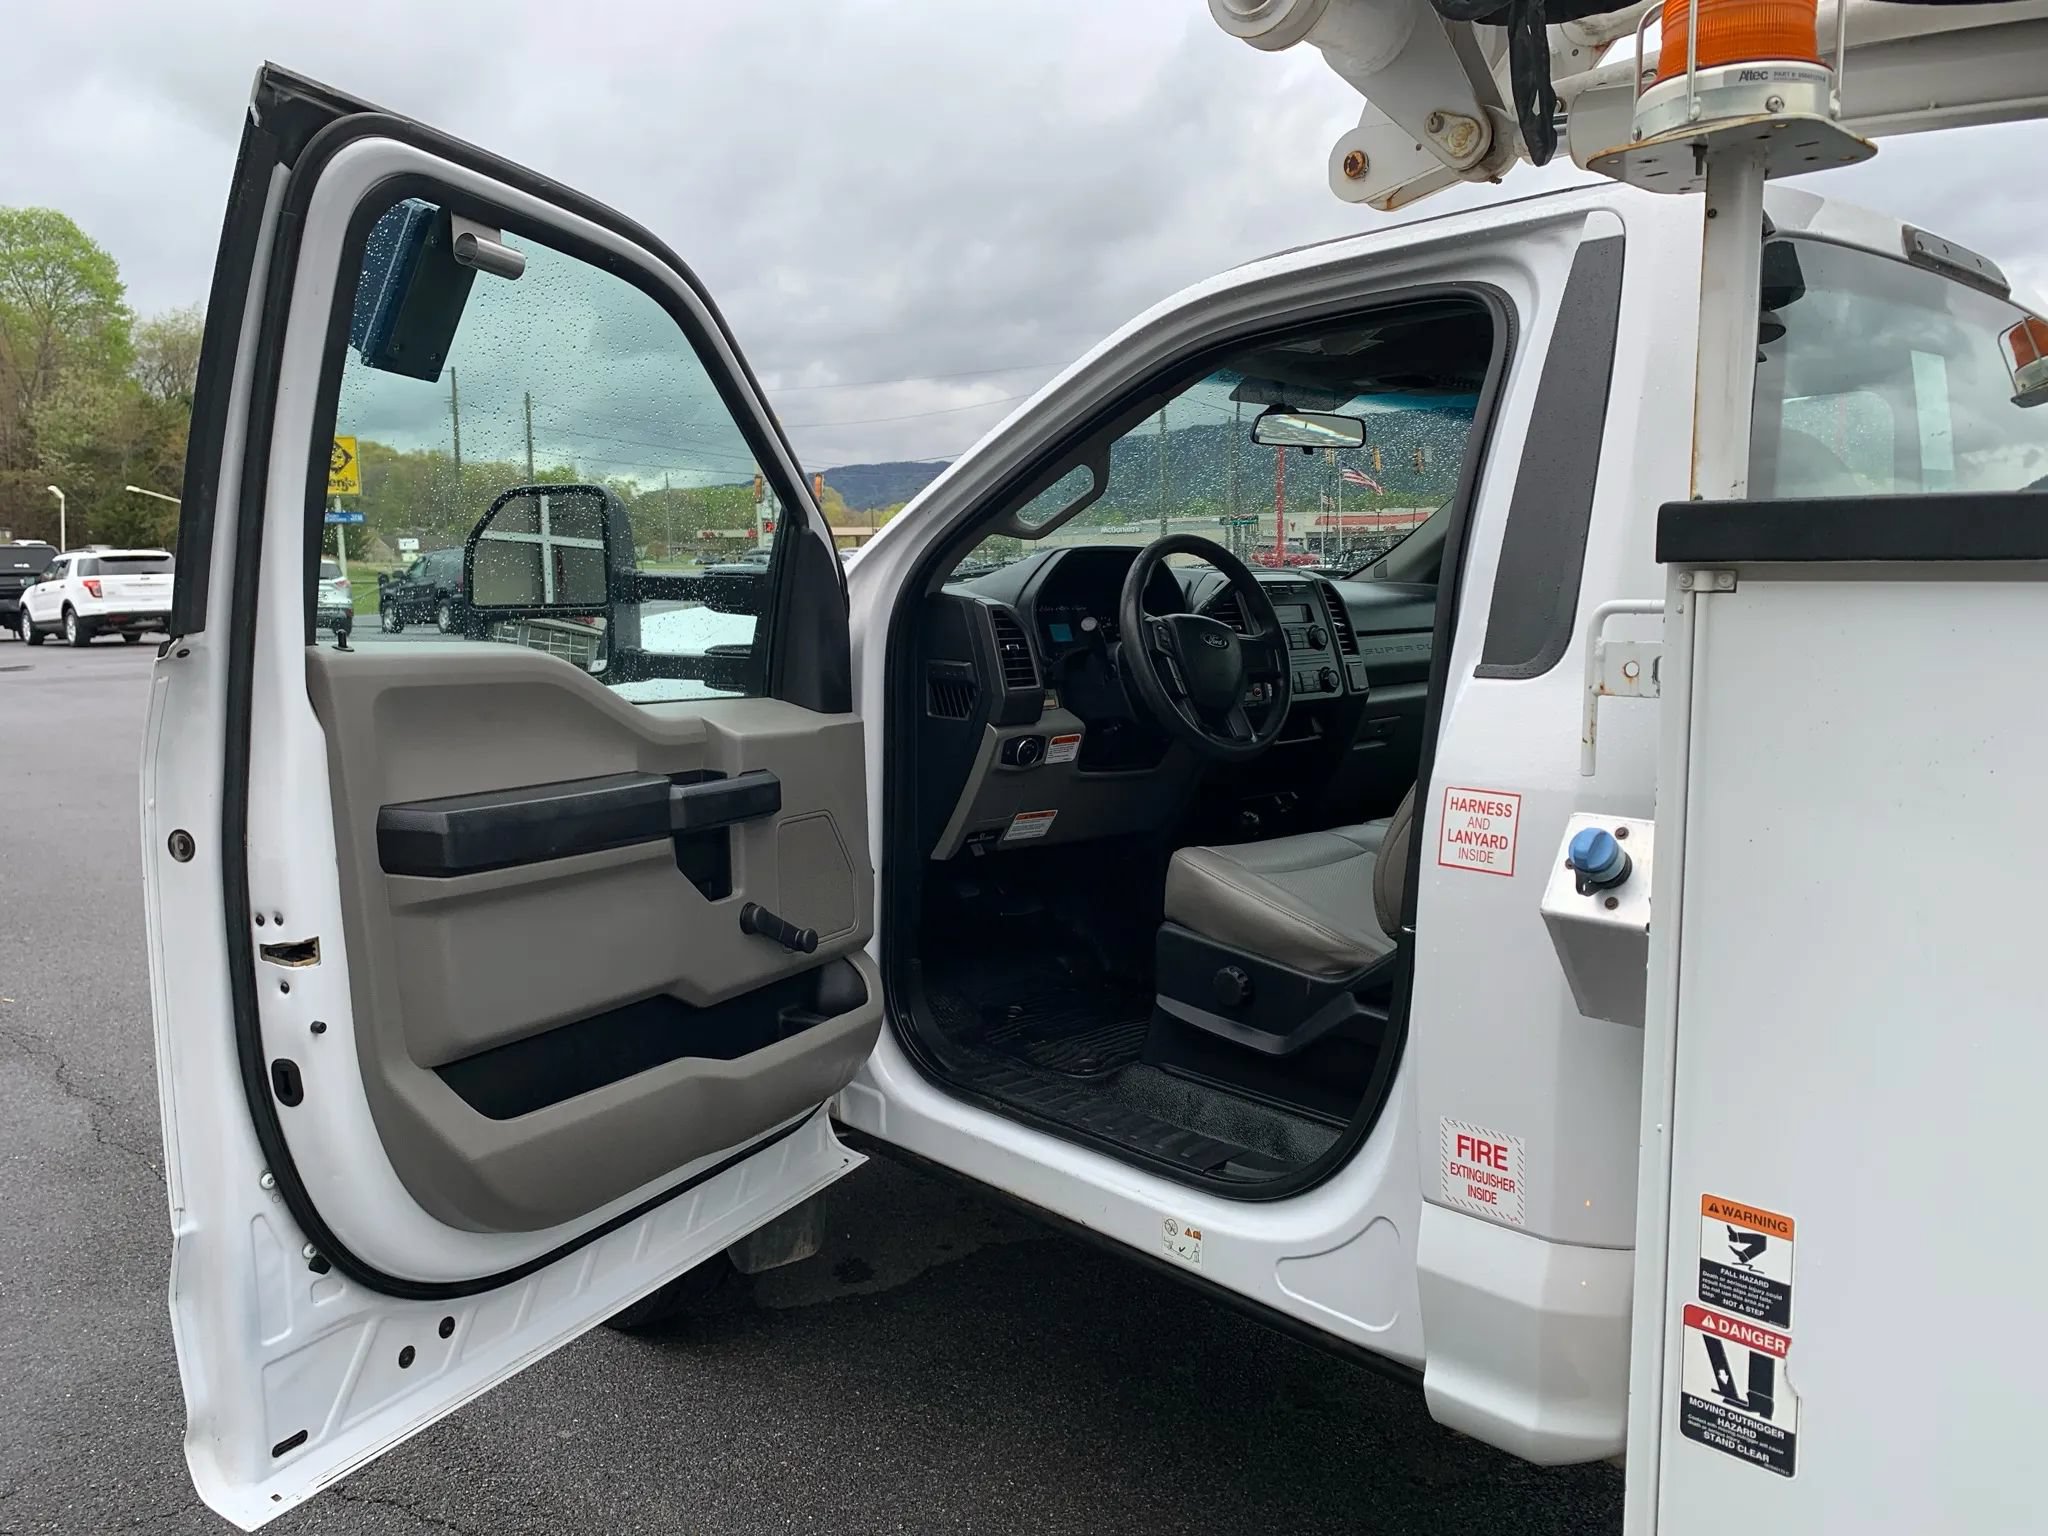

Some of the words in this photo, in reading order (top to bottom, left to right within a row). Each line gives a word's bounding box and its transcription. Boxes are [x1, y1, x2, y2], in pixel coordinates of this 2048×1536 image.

[1739, 70, 1768, 82] Altec
[1450, 796, 1513, 818] HARNESS
[1467, 816, 1491, 830] AND
[1447, 827, 1508, 850] LANYARD
[1458, 847, 1494, 864] INSIDE
[1457, 1134, 1508, 1171] FIRE
[1450, 1161, 1516, 1193] EXTINGUISHER
[1467, 1184, 1498, 1205] INSIDE
[1722, 1204, 1788, 1233] WARNING
[1702, 1270, 1719, 1280] Death
[1720, 1268, 1738, 1279] FALL
[1739, 1274, 1769, 1288] HAZARD
[1723, 1298, 1738, 1308] NOT
[1745, 1306, 1764, 1316] STEP
[1718, 1318, 1786, 1354] DANGER
[1689, 1396, 1726, 1417] MOVING
[1728, 1412, 1785, 1440] OUTRIGGER
[1717, 1418, 1757, 1439] HAZARD
[1704, 1431, 1735, 1449] STAND
[1737, 1444, 1770, 1463] CLEAR
